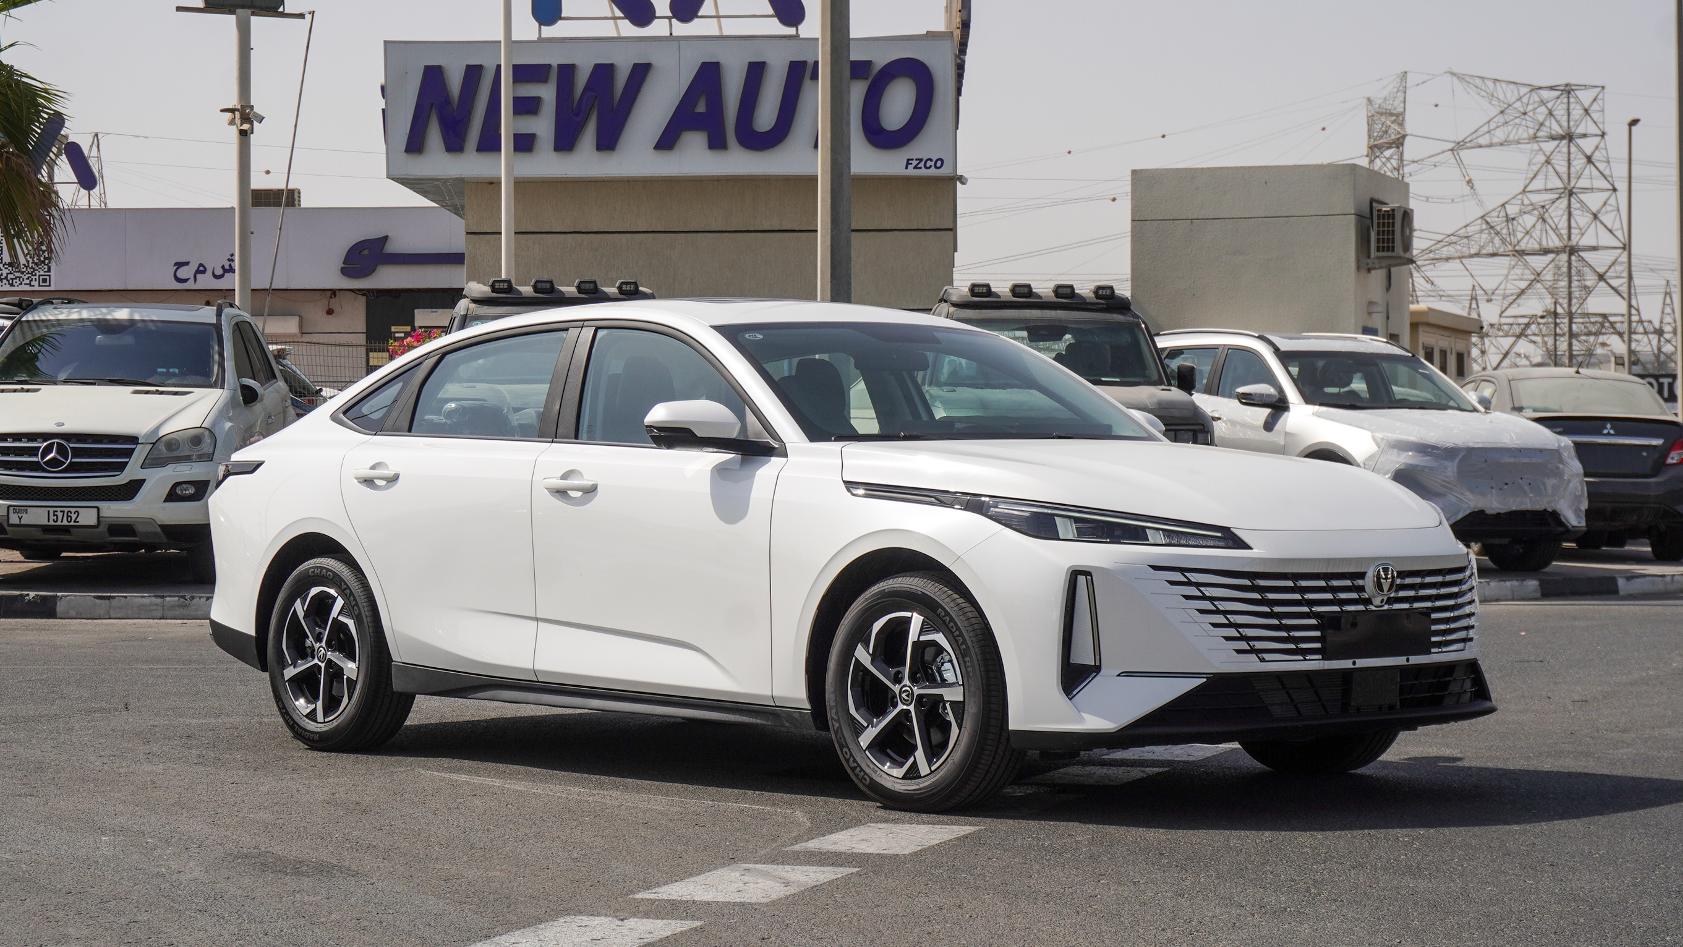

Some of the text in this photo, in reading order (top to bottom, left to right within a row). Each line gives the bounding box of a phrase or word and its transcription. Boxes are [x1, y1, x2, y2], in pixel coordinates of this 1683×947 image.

[404, 57, 935, 154] NEW AUO
[904, 157, 945, 170] FZCO
[17, 509, 80, 524] Y 15762
